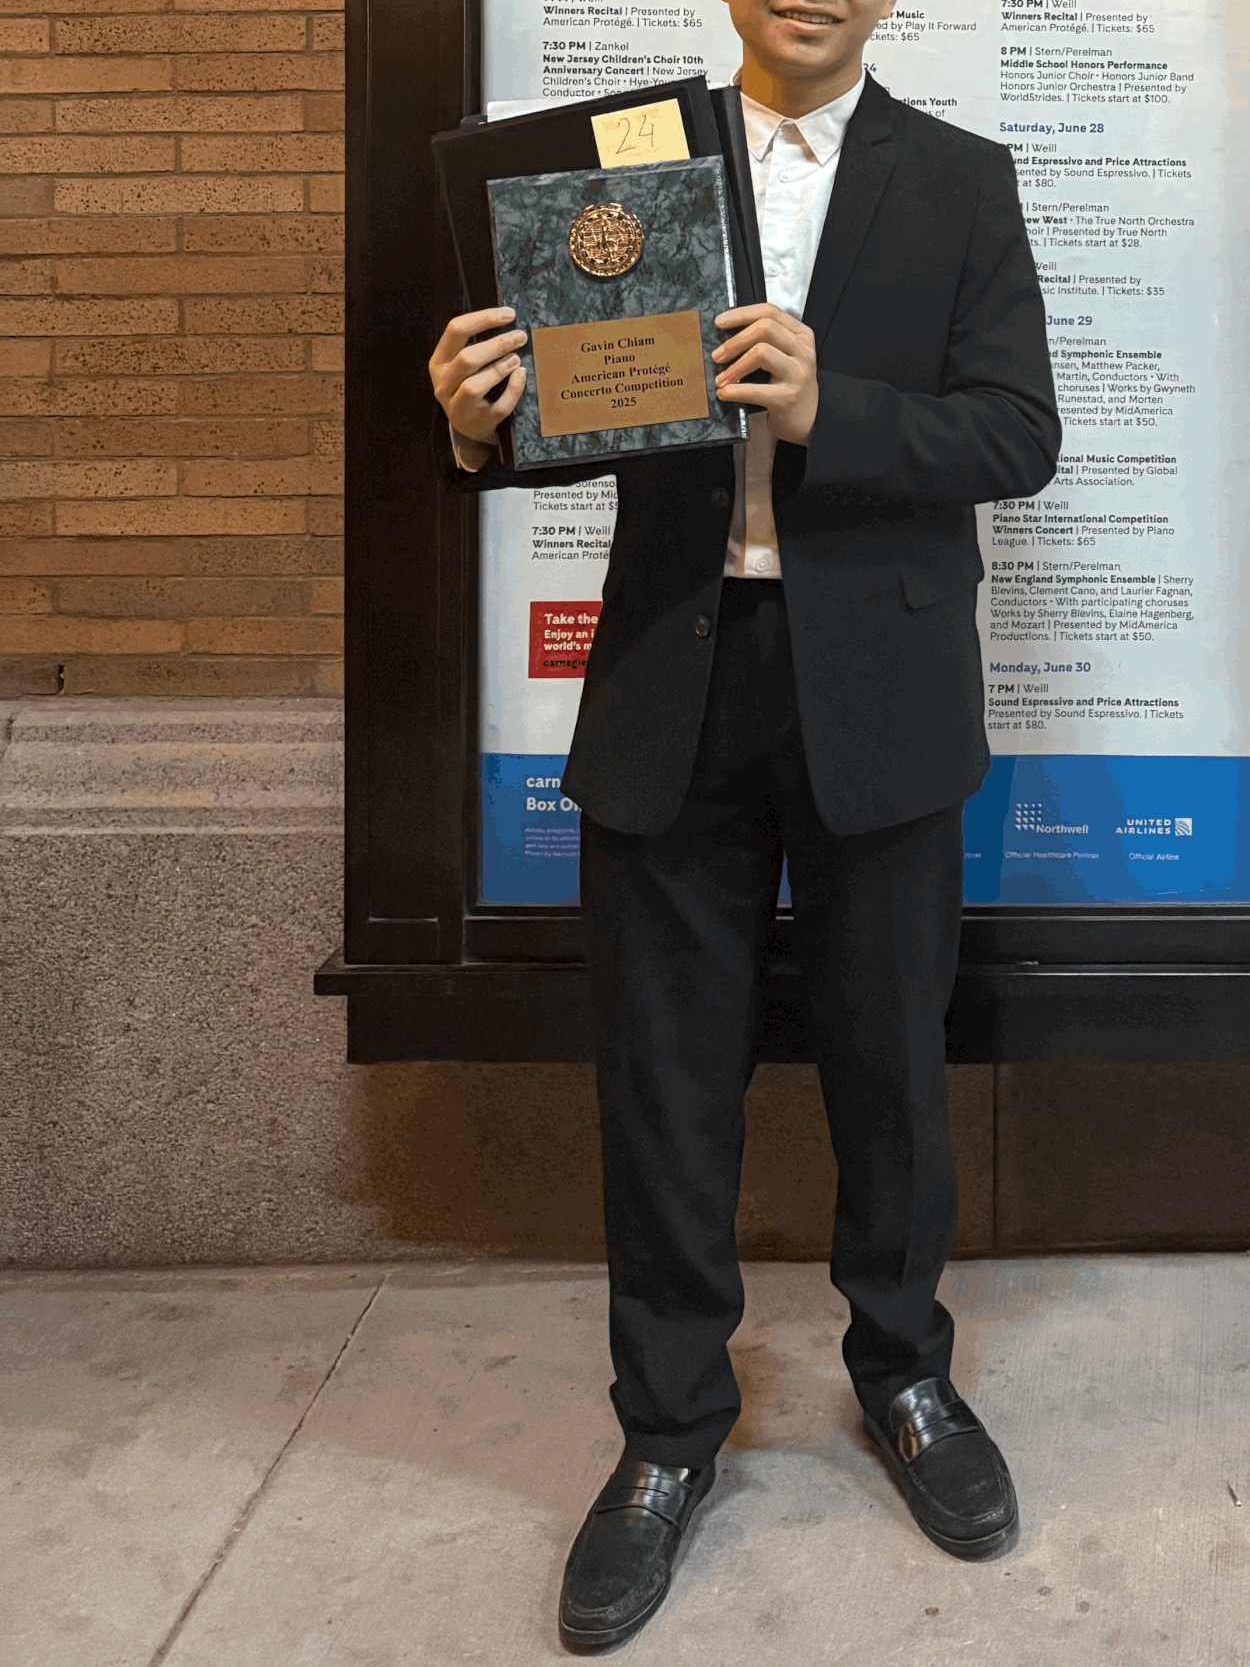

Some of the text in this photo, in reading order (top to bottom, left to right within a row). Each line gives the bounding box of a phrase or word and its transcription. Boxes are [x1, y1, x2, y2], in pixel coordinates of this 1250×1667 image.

[542, 6, 696, 20] Winners Recital Presented by
[542, 15, 703, 29] American Protégé. Tickets: $65
[541, 40, 629, 52] 7:30 PM Zankel
[1000, 46, 1113, 57] 8 PM Stern/Perelman
[1000, 59, 1168, 70] Middle School Honors Performance
[615, 114, 656, 155] 24
[999, 121, 1105, 136] Saturday, June 28
[1046, 315, 1093, 327] June 29
[580, 337, 655, 353] Gavin Chiam
[604, 354, 636, 365] Piano
[571, 362, 671, 385] American Protégé
[560, 378, 684, 400] Concerto Competition
[611, 396, 638, 409] 2025
[543, 613, 599, 625] Take the
[543, 629, 589, 641] Enjoy an
[543, 641, 582, 651] world's
[989, 661, 1091, 676] Monday, June 30
[525, 797, 556, 812] Box
[1126, 817, 1172, 828] UNITED
[1035, 824, 1089, 835] Northwell
[1115, 825, 1172, 837] AIRLINES
